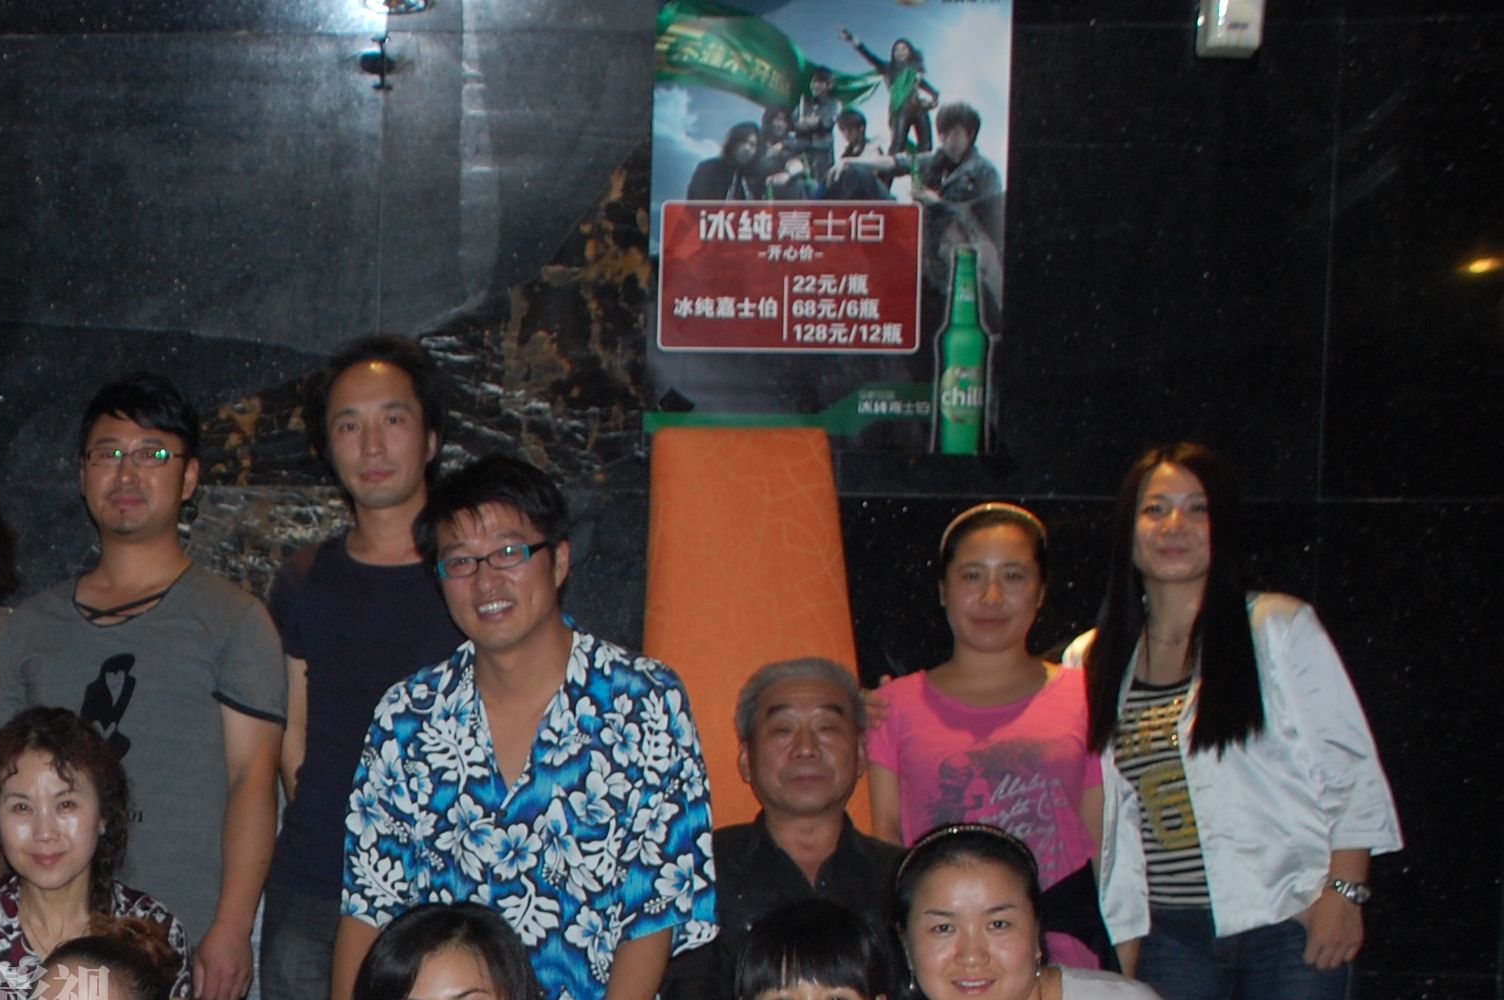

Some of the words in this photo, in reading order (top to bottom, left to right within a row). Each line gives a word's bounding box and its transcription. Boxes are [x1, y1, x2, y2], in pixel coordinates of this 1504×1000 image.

[699, 210, 885, 242] 冰纯嘉士伯
[792, 274, 869, 295] 22元/瓶
[673, 298, 778, 319] 冰纯嘉士伯
[792, 299, 880, 320] 68元/6瓶
[793, 324, 903, 345] 128元/12瓶
[941, 387, 983, 406] chill
